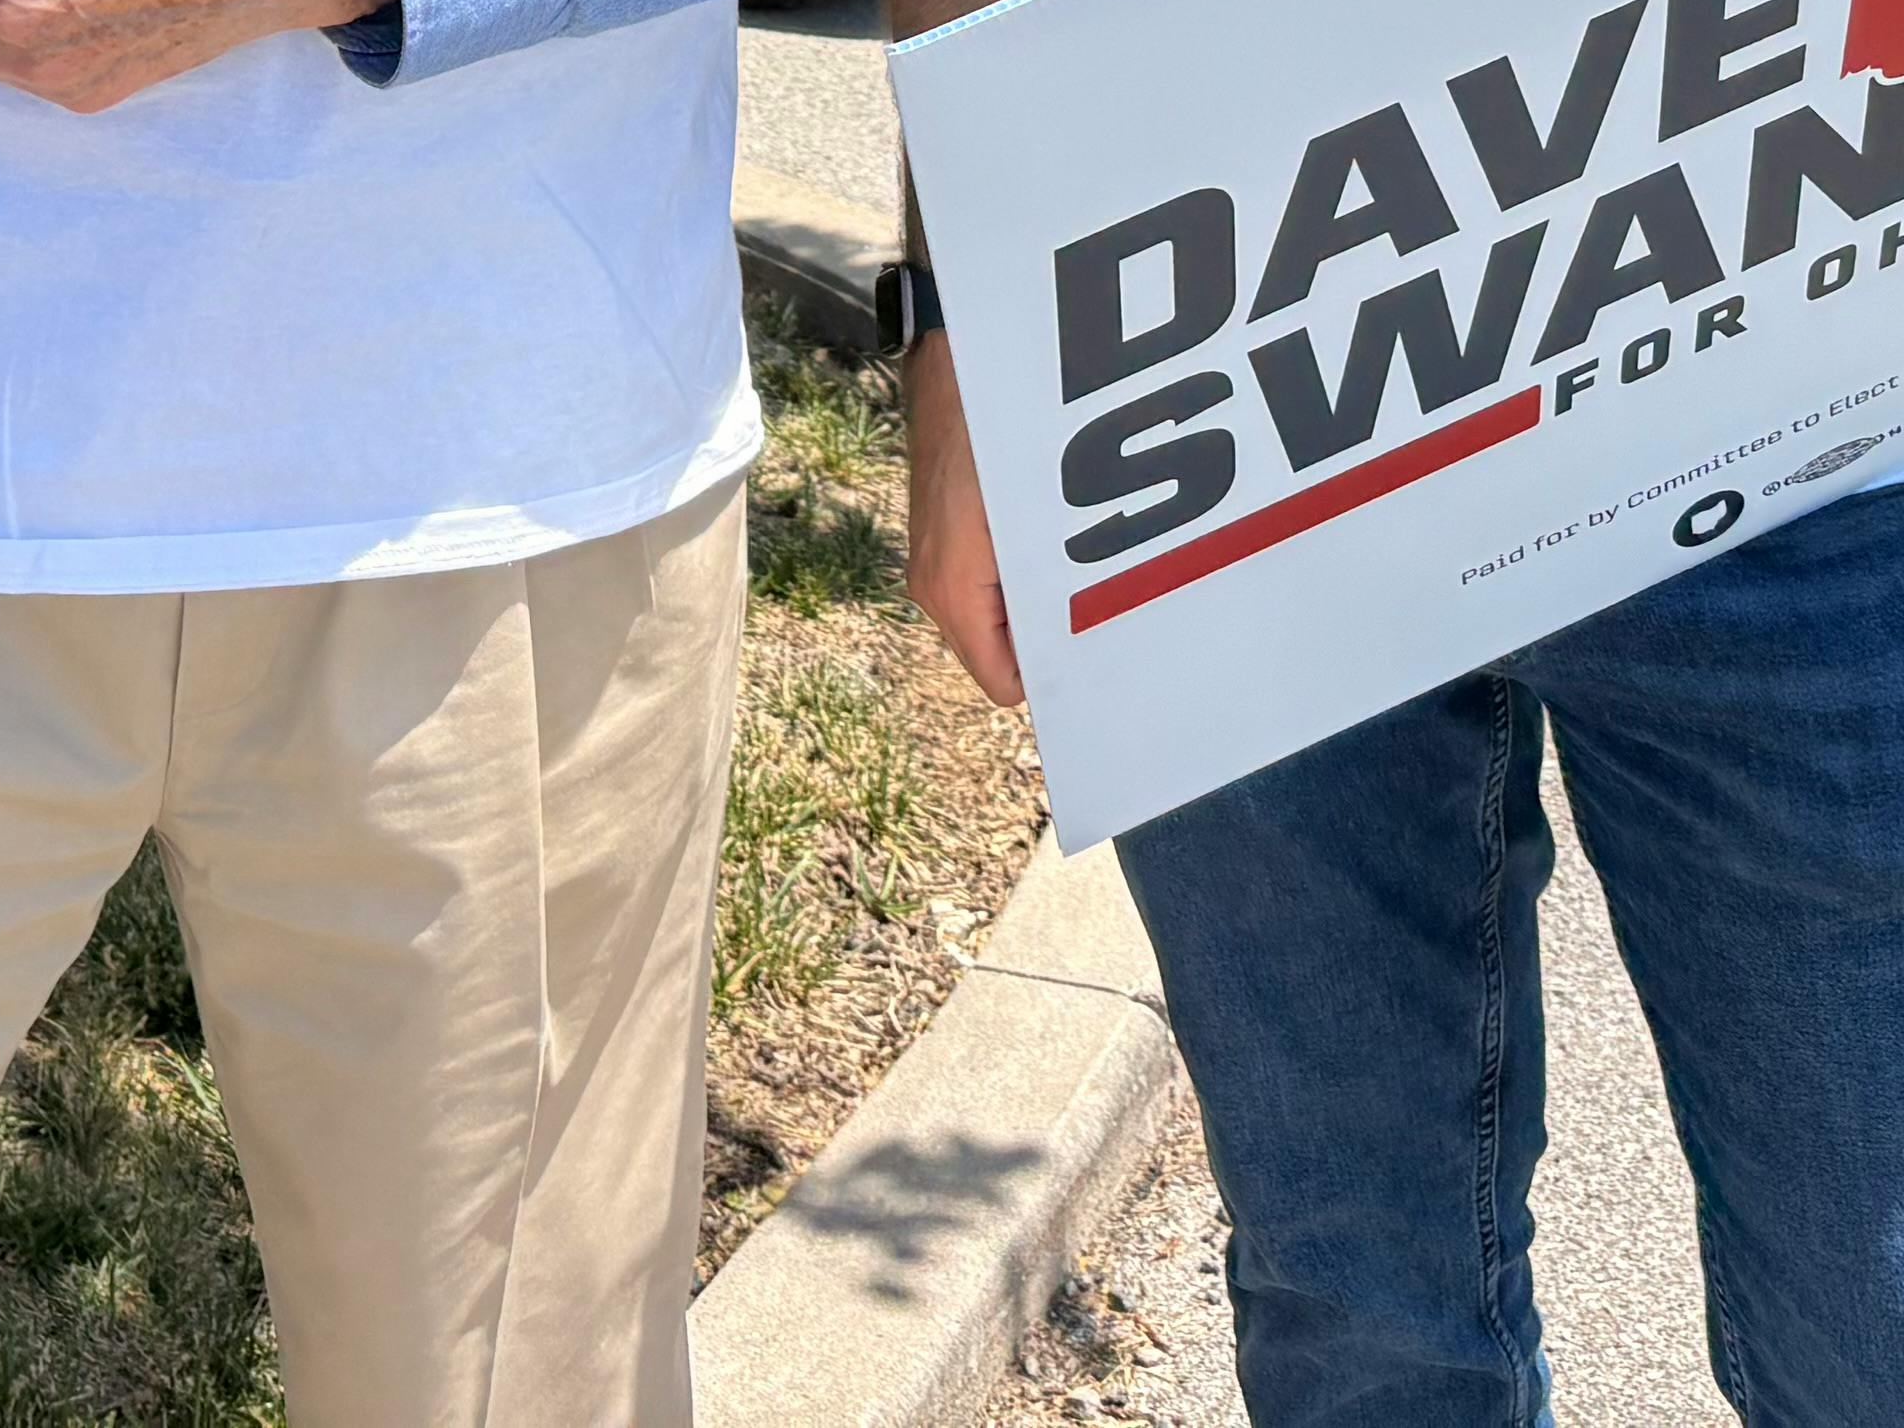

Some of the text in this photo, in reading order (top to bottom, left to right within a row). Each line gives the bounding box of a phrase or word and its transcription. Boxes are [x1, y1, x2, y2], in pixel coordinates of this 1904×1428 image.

[1554, 294, 1748, 418] FOR
[1461, 545, 1525, 586] Paid
[1533, 522, 1580, 552] for
[1588, 504, 1620, 528] by
[1627, 429, 1783, 510] Committee
[1790, 412, 1821, 434] to
[1829, 375, 1900, 418] Elect
